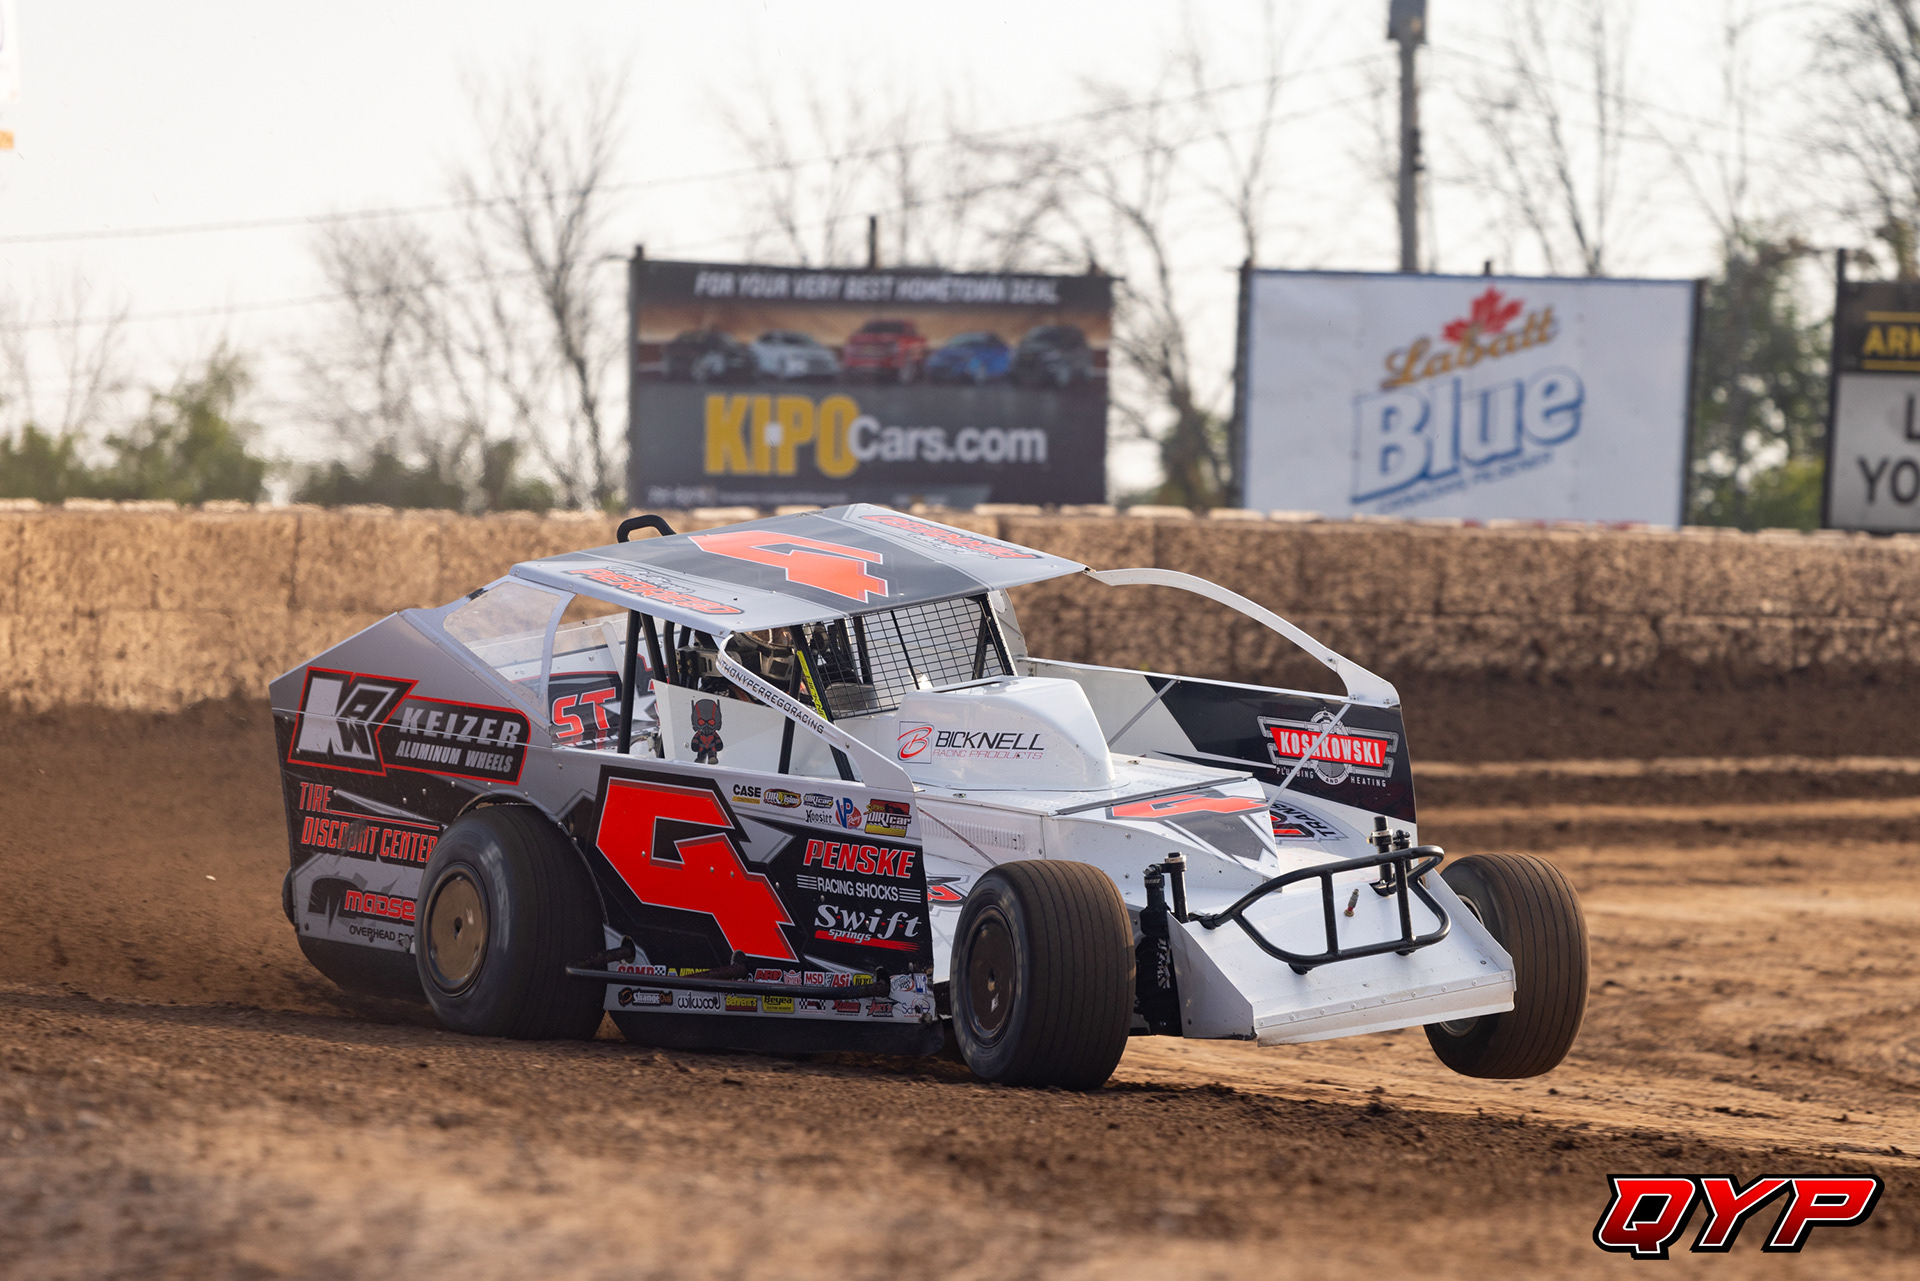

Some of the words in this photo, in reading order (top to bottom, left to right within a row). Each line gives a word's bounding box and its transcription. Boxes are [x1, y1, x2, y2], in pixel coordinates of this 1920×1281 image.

[694, 271, 735, 298] FOR
[737, 272, 790, 299] YOUR
[844, 275, 893, 301] BEST
[895, 276, 1005, 303] HOMETOWN
[1380, 303, 1557, 391] Labatt
[1352, 366, 1585, 504] Blue
[690, 530, 888, 603] 4
[719, 659, 826, 734] THONYPERREGORACING
[399, 706, 522, 749] KEIZER
[935, 731, 1044, 750] BICKNELL
[395, 740, 462, 766] ALUMINUM
[464, 750, 513, 773] WHEELS
[933, 749, 966, 758] RACING
[969, 750, 1043, 760] PRODUCTS
[1280, 731, 1380, 764] KOSAKOWSKI
[1276, 766, 1314, 779] PLUBING
[1350, 776, 1387, 788] HEATING
[299, 782, 333, 813] TIRE
[733, 784, 762, 798] CASE
[836, 798, 854, 829] VP
[301, 816, 380, 855] DISCOUNT
[596, 777, 799, 962] 4
[803, 839, 916, 879] PENSKE
[817, 876, 854, 896] RACING
[855, 882, 899, 901] SHOCKS
[344, 889, 417, 921] MADSE
[349, 925, 396, 941] OVERHEAD
[814, 904, 922, 940] Swift
[828, 928, 872, 943] springs
[754, 969, 782, 981] ARP
[805, 972, 824, 985] MSD
[678, 991, 721, 1010] wilwood
